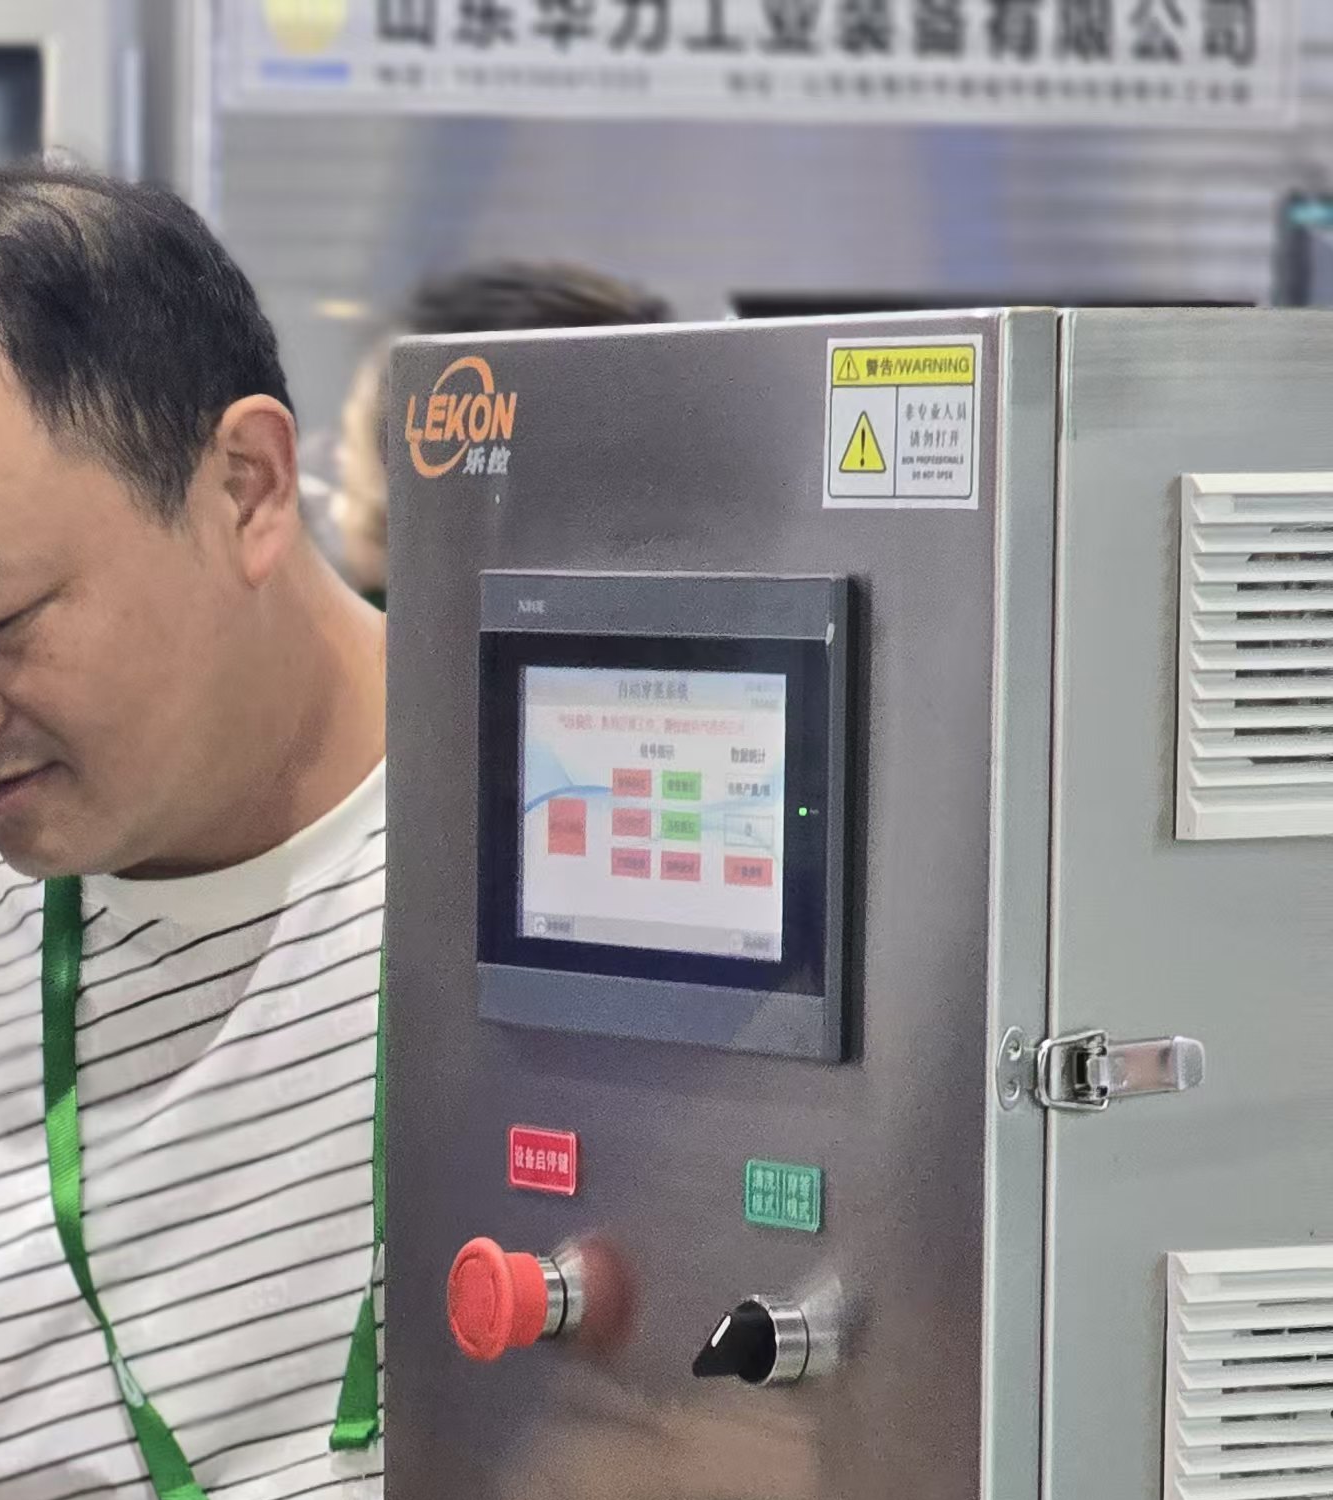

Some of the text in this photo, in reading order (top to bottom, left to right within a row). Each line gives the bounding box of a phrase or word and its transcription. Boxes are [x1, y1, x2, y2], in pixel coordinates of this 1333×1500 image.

[405, 391, 518, 442] LEKON
[905, 402, 967, 421] 非专业人员
[910, 429, 960, 448] 请勿打开
